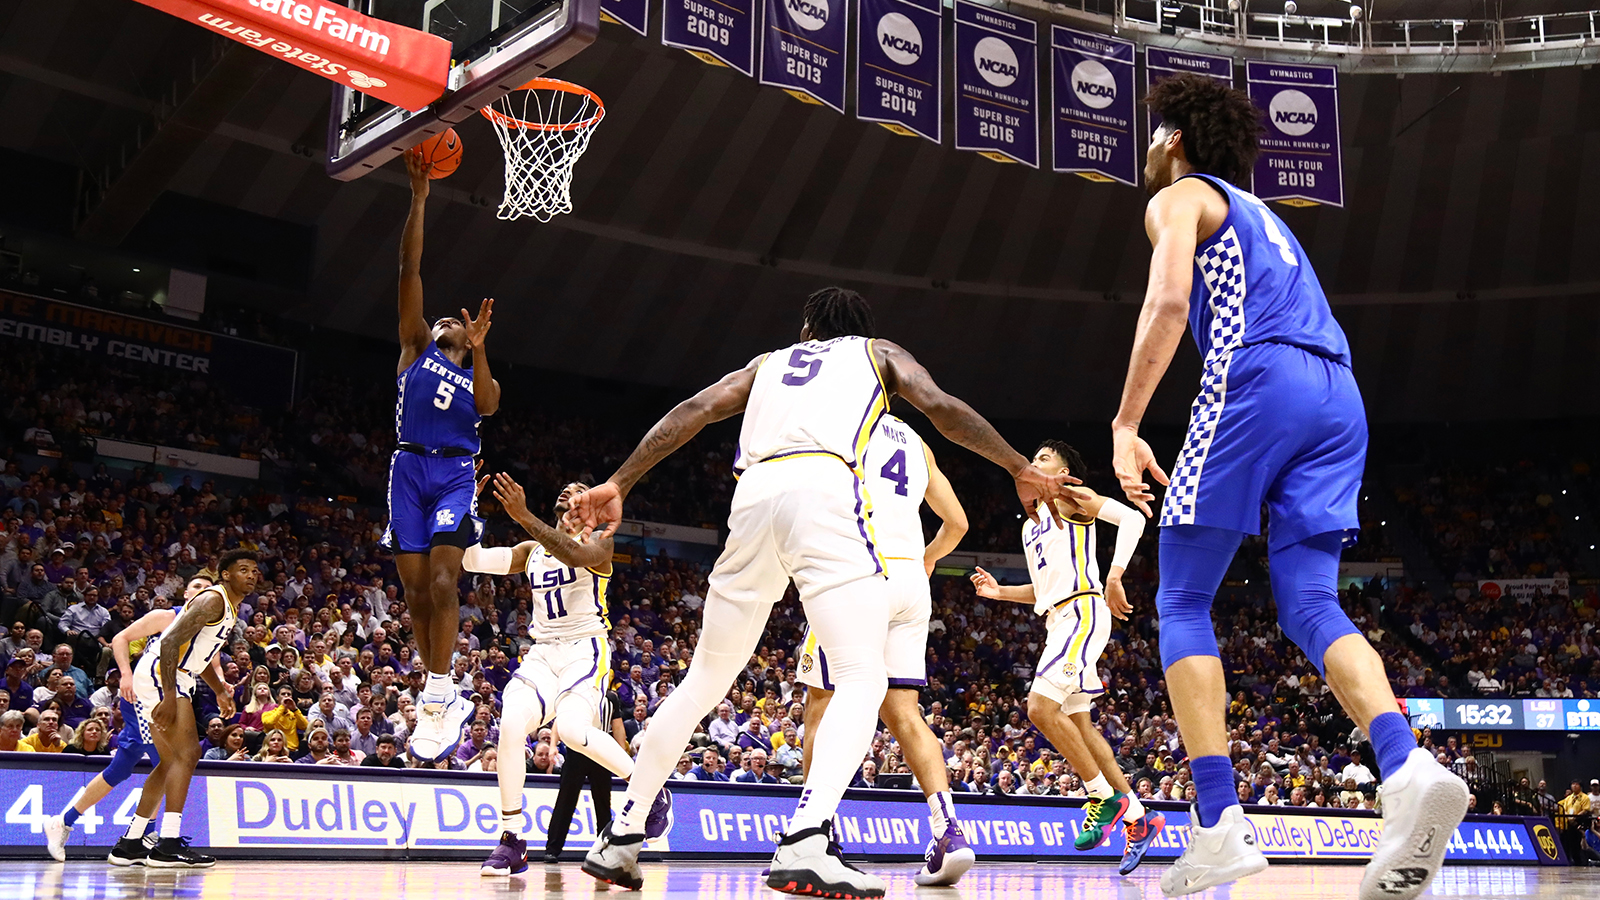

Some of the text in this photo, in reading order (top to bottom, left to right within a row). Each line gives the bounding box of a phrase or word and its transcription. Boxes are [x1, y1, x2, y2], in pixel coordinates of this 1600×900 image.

[684, 0, 734, 28] SUPER SIX
[788, 0, 828, 23] NCAA
[976, 12, 1016, 30] GYMNASTICS
[687, 15, 730, 46] 2009
[781, 41, 828, 68] SUPER SIX
[882, 33, 921, 57] NCAA
[1073, 37, 1114, 54] GYMNASTICS
[786, 58, 822, 84] 2013
[979, 57, 1018, 79] NCAA
[1168, 56, 1210, 70] GYMNASTICS
[1270, 69, 1314, 80] GYMNASTICS
[875, 76, 922, 100] SUPER SIX
[964, 84, 1030, 107] NATIONAL RUNNER-UP
[1076, 80, 1116, 100] NCAA
[881, 92, 917, 117] 2014
[974, 106, 1020, 128] SUPER SIX
[1060, 107, 1128, 127] NATIONAL RUNNER-UP
[1275, 111, 1316, 125] NCAA
[980, 122, 1014, 144] 2016
[1071, 128, 1118, 148] SUPER SIX
[1259, 138, 1331, 150] NATIONAL RUNNER-UP
[1078, 142, 1112, 163] 2017
[1269, 158, 1323, 171] FINAL FOUR
[1278, 172, 1316, 188] 2019
[46, 303, 213, 353] MARAVICH
[107, 340, 210, 374] CENTER
[782, 348, 831, 386] 5
[433, 380, 456, 410] 5
[882, 424, 907, 444] MAYS
[880, 448, 908, 497] 4
[1024, 516, 1052, 548] LSU
[1036, 542, 1047, 570] 2
[530, 567, 577, 590] LSU
[544, 588, 568, 620] 11
[1456, 704, 1513, 725] 15:32
[1530, 701, 1556, 712] LSU
[1417, 713, 1437, 727] 40
[1536, 714, 1556, 728] 37
[1461, 733, 1503, 748] LSU
[235, 780, 416, 846] Dudley
[699, 809, 791, 842] OFFICI
[928, 816, 1034, 846] WYERS
[1040, 822, 1065, 846] OF
[1538, 836, 1556, 855] ups
